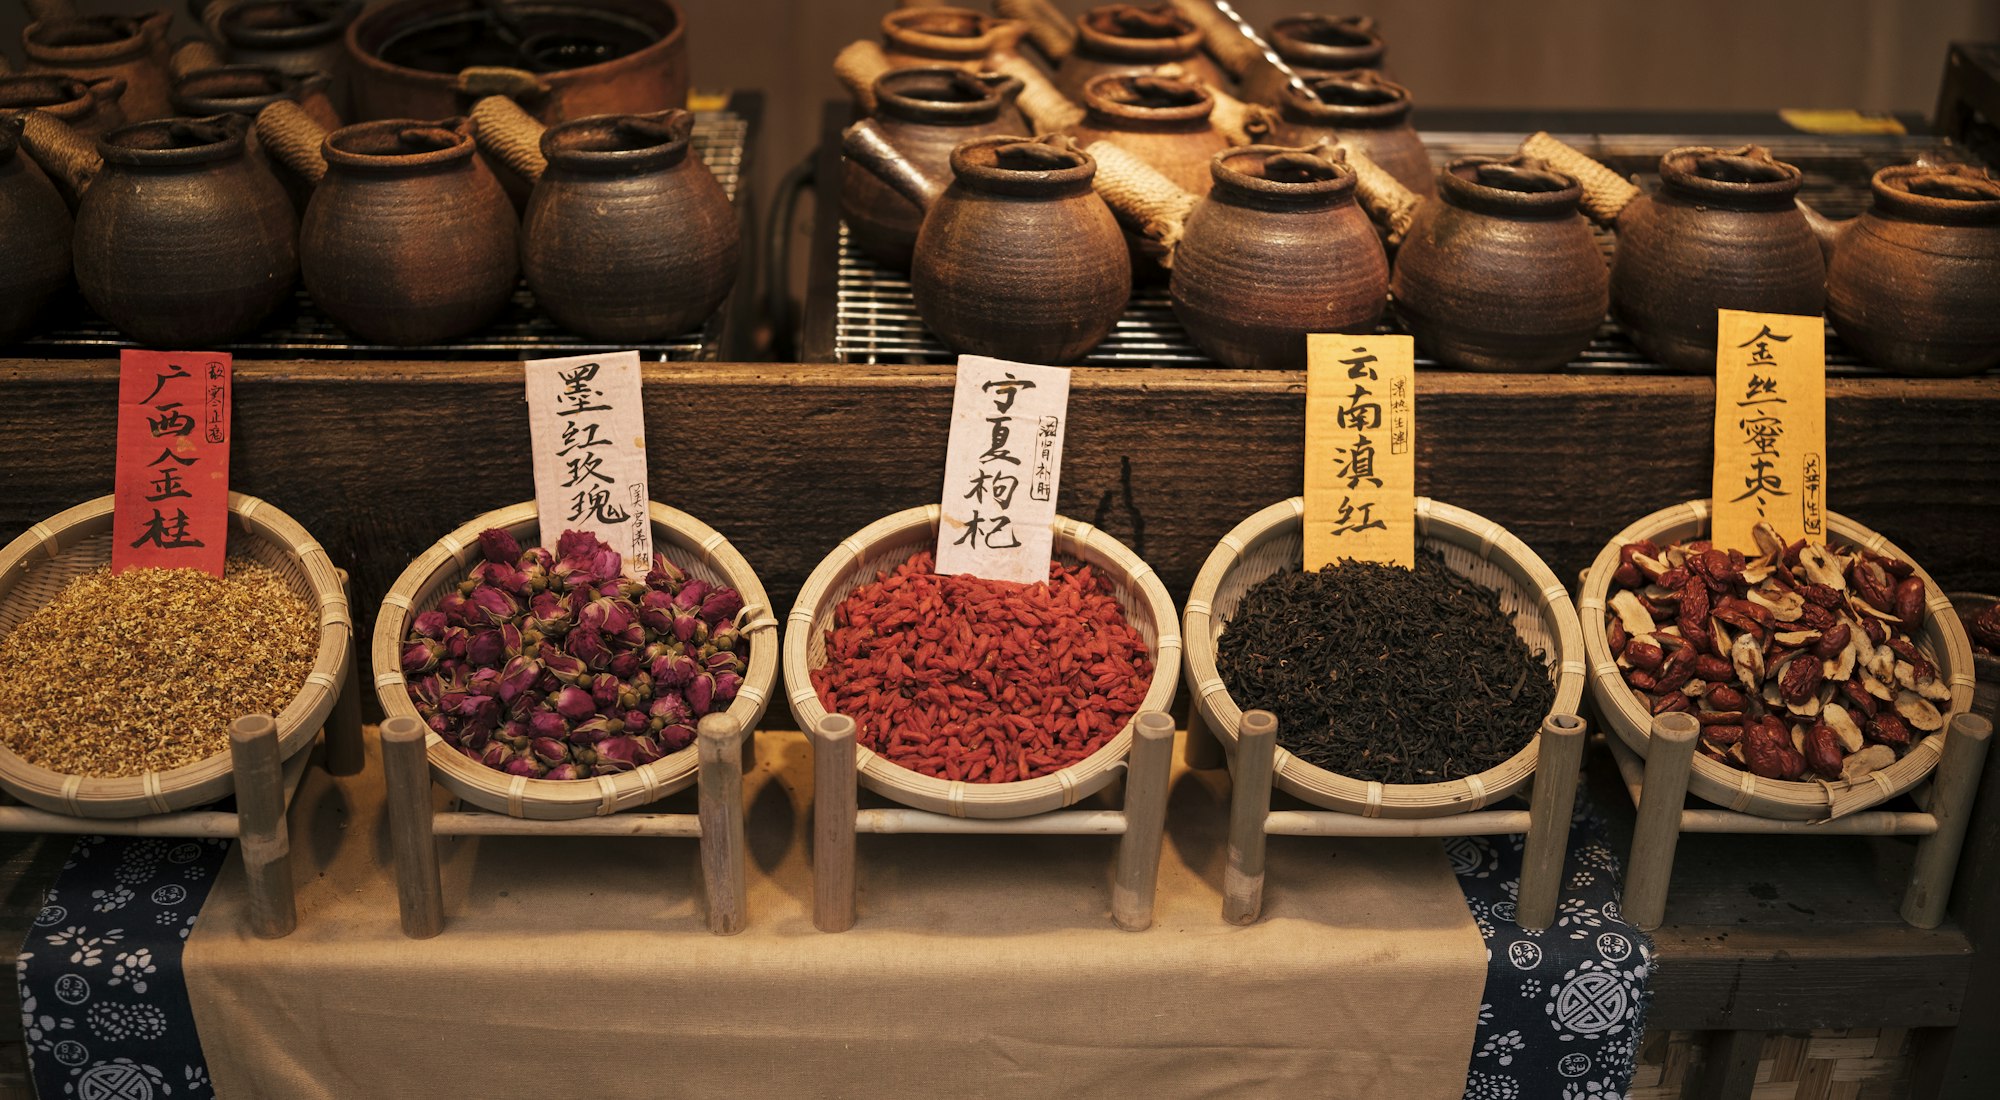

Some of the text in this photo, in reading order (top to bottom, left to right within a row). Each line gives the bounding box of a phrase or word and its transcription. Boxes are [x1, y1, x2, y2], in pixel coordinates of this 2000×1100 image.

[130, 365, 205, 550] 广西金桂
[555, 362, 631, 526] 墨红玫瑰
[953, 372, 1037, 550] 宁夏枸杞
[1330, 346, 1387, 536] 云南滇红
[1729, 324, 1793, 518] 金丝蜜枣
